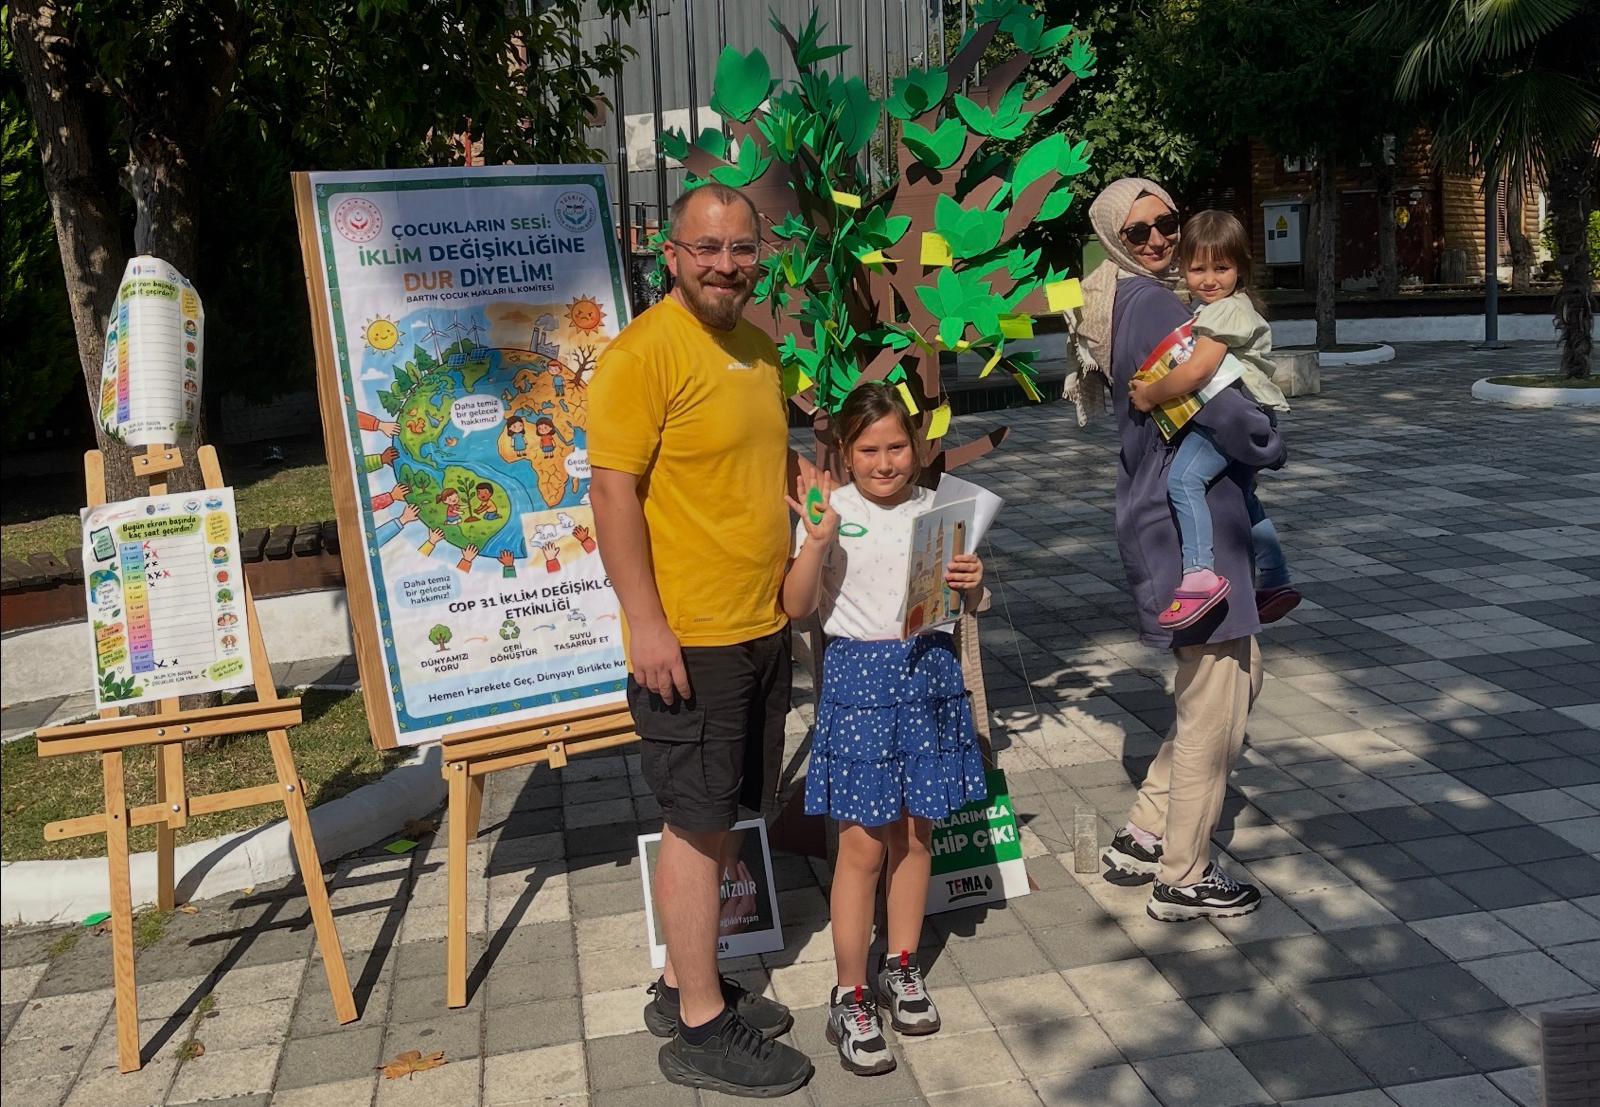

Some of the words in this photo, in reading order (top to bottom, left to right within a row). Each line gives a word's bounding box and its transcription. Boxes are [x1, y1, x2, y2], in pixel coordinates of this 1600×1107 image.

[391, 218, 505, 240] ÇOCUKLARIN
[511, 213, 552, 231] SESİ:
[359, 242, 422, 267] İKLİM
[429, 233, 586, 263] DEĞİŞİKLİĞİNE
[403, 270, 454, 292] DUR
[460, 260, 553, 289] DİYELİM!
[406, 293, 438, 303] BARTIN
[440, 291, 469, 302] ÇOCUK
[471, 287, 507, 298] HAKLARI
[508, 286, 516, 294] İL
[517, 283, 555, 293] KOMİTESİ
[454, 402, 476, 411] Daha
[477, 400, 498, 408] temiz
[456, 410, 468, 419] bir
[468, 407, 499, 418] gelecek
[461, 415, 497, 426] hakkımız!
[122, 522, 145, 535] Bugün
[147, 519, 168, 528] ekran
[169, 515, 197, 525] başında
[128, 531, 141, 540] kaç
[144, 528, 161, 538] saat
[162, 523, 194, 537] geçirdin?
[403, 580, 426, 589] Daha
[449, 600, 476, 613] COP
[480, 597, 498, 609] 31
[499, 589, 538, 605] İKLİM
[541, 576, 613, 598] DEĞİŞİKLĞ
[505, 597, 571, 620] ETKİNLİĞİ
[553, 638, 597, 651] TASARRUF
[599, 635, 609, 643] ET
[569, 631, 592, 641] SUYU
[490, 648, 538, 664] DÖNÜŞTÜR
[503, 642, 523, 653] GERİ
[420, 653, 469, 668] DÜNYAMIZI
[434, 663, 459, 673] KORU
[428, 691, 465, 702] Hemen
[466, 681, 511, 695] Harekete
[537, 670, 575, 682] Dünyayı
[577, 662, 612, 675] Birlikte
[931, 804, 1010, 831] NLARIMIZA
[931, 830, 969, 857] HİP
[972, 824, 1016, 853] ÇIK!
[720, 879, 757, 899] MİZDİR
[946, 875, 983, 896] TEMA
